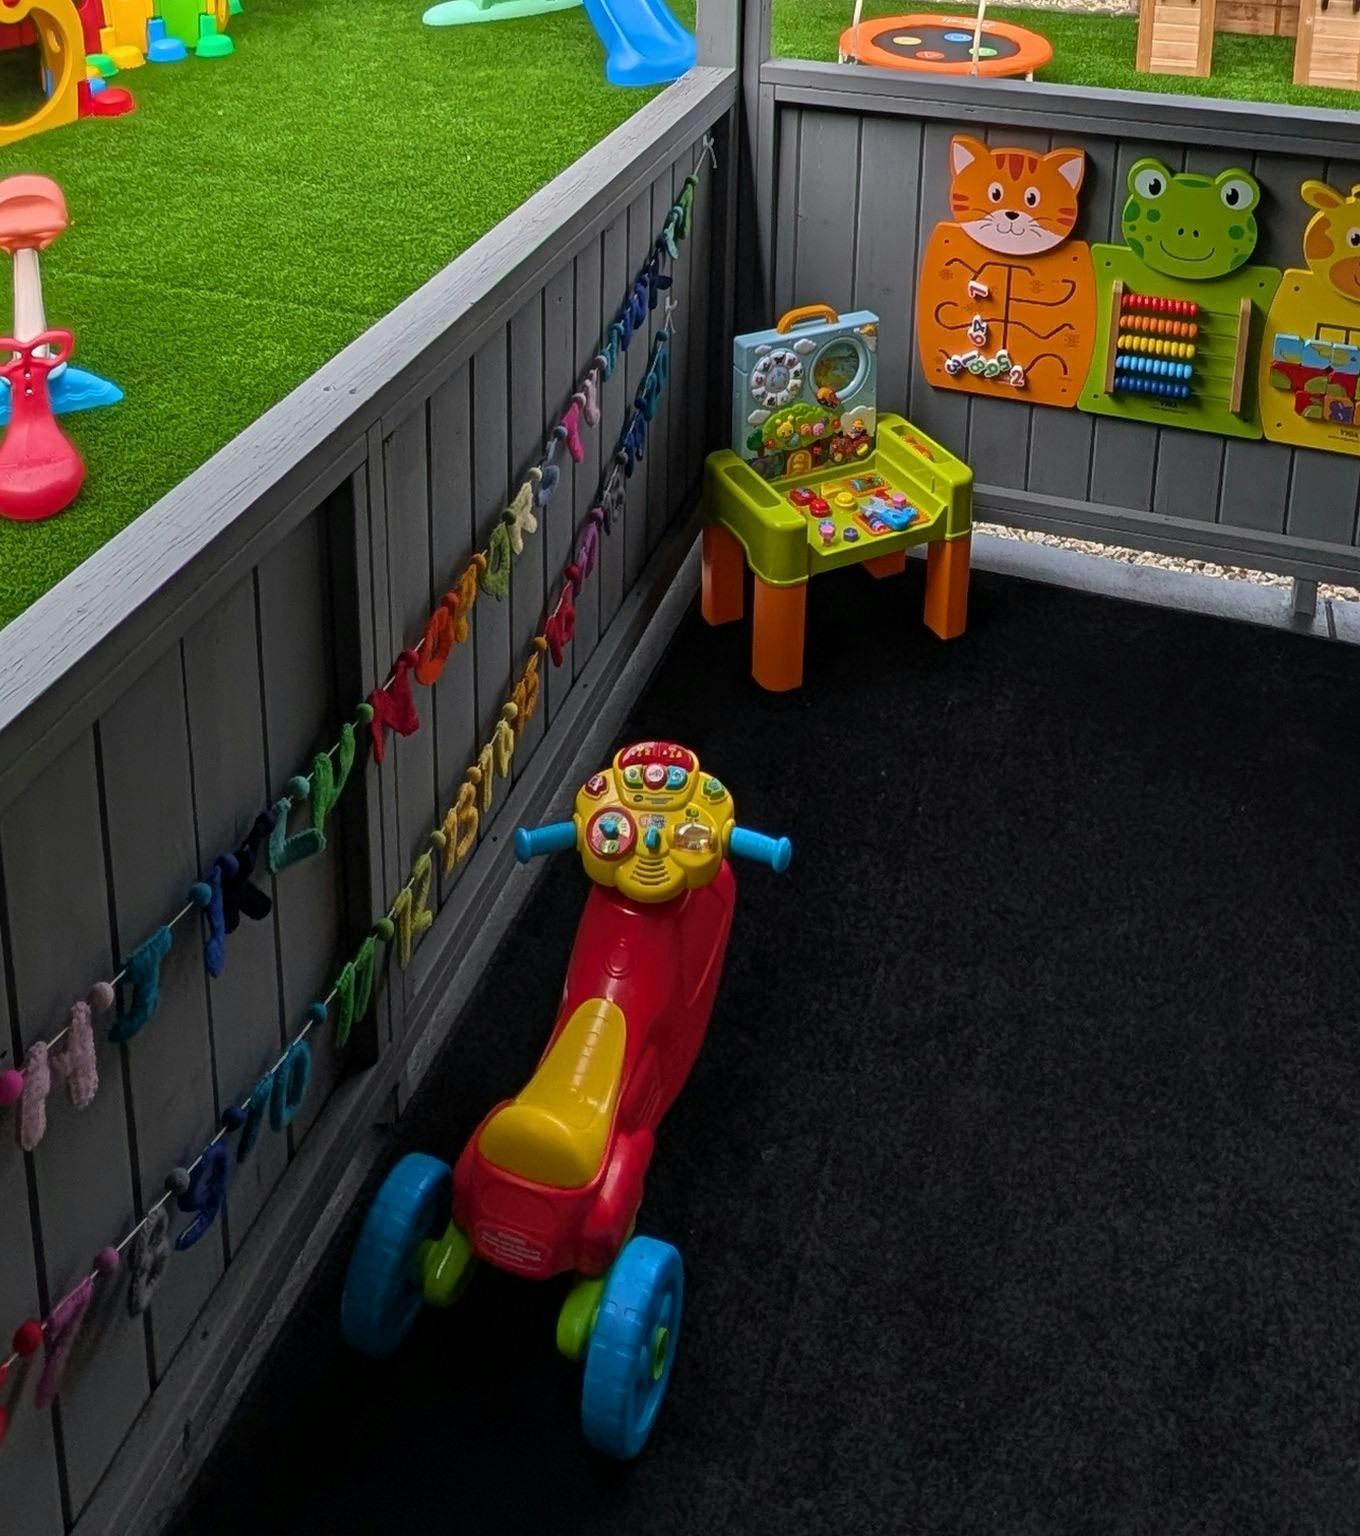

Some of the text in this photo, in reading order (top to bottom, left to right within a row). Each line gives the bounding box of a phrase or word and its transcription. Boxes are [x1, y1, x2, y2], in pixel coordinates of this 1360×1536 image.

[1010, 368, 1025, 385] 2
[269, 796, 327, 875] L
[415, 606, 454, 686] O
